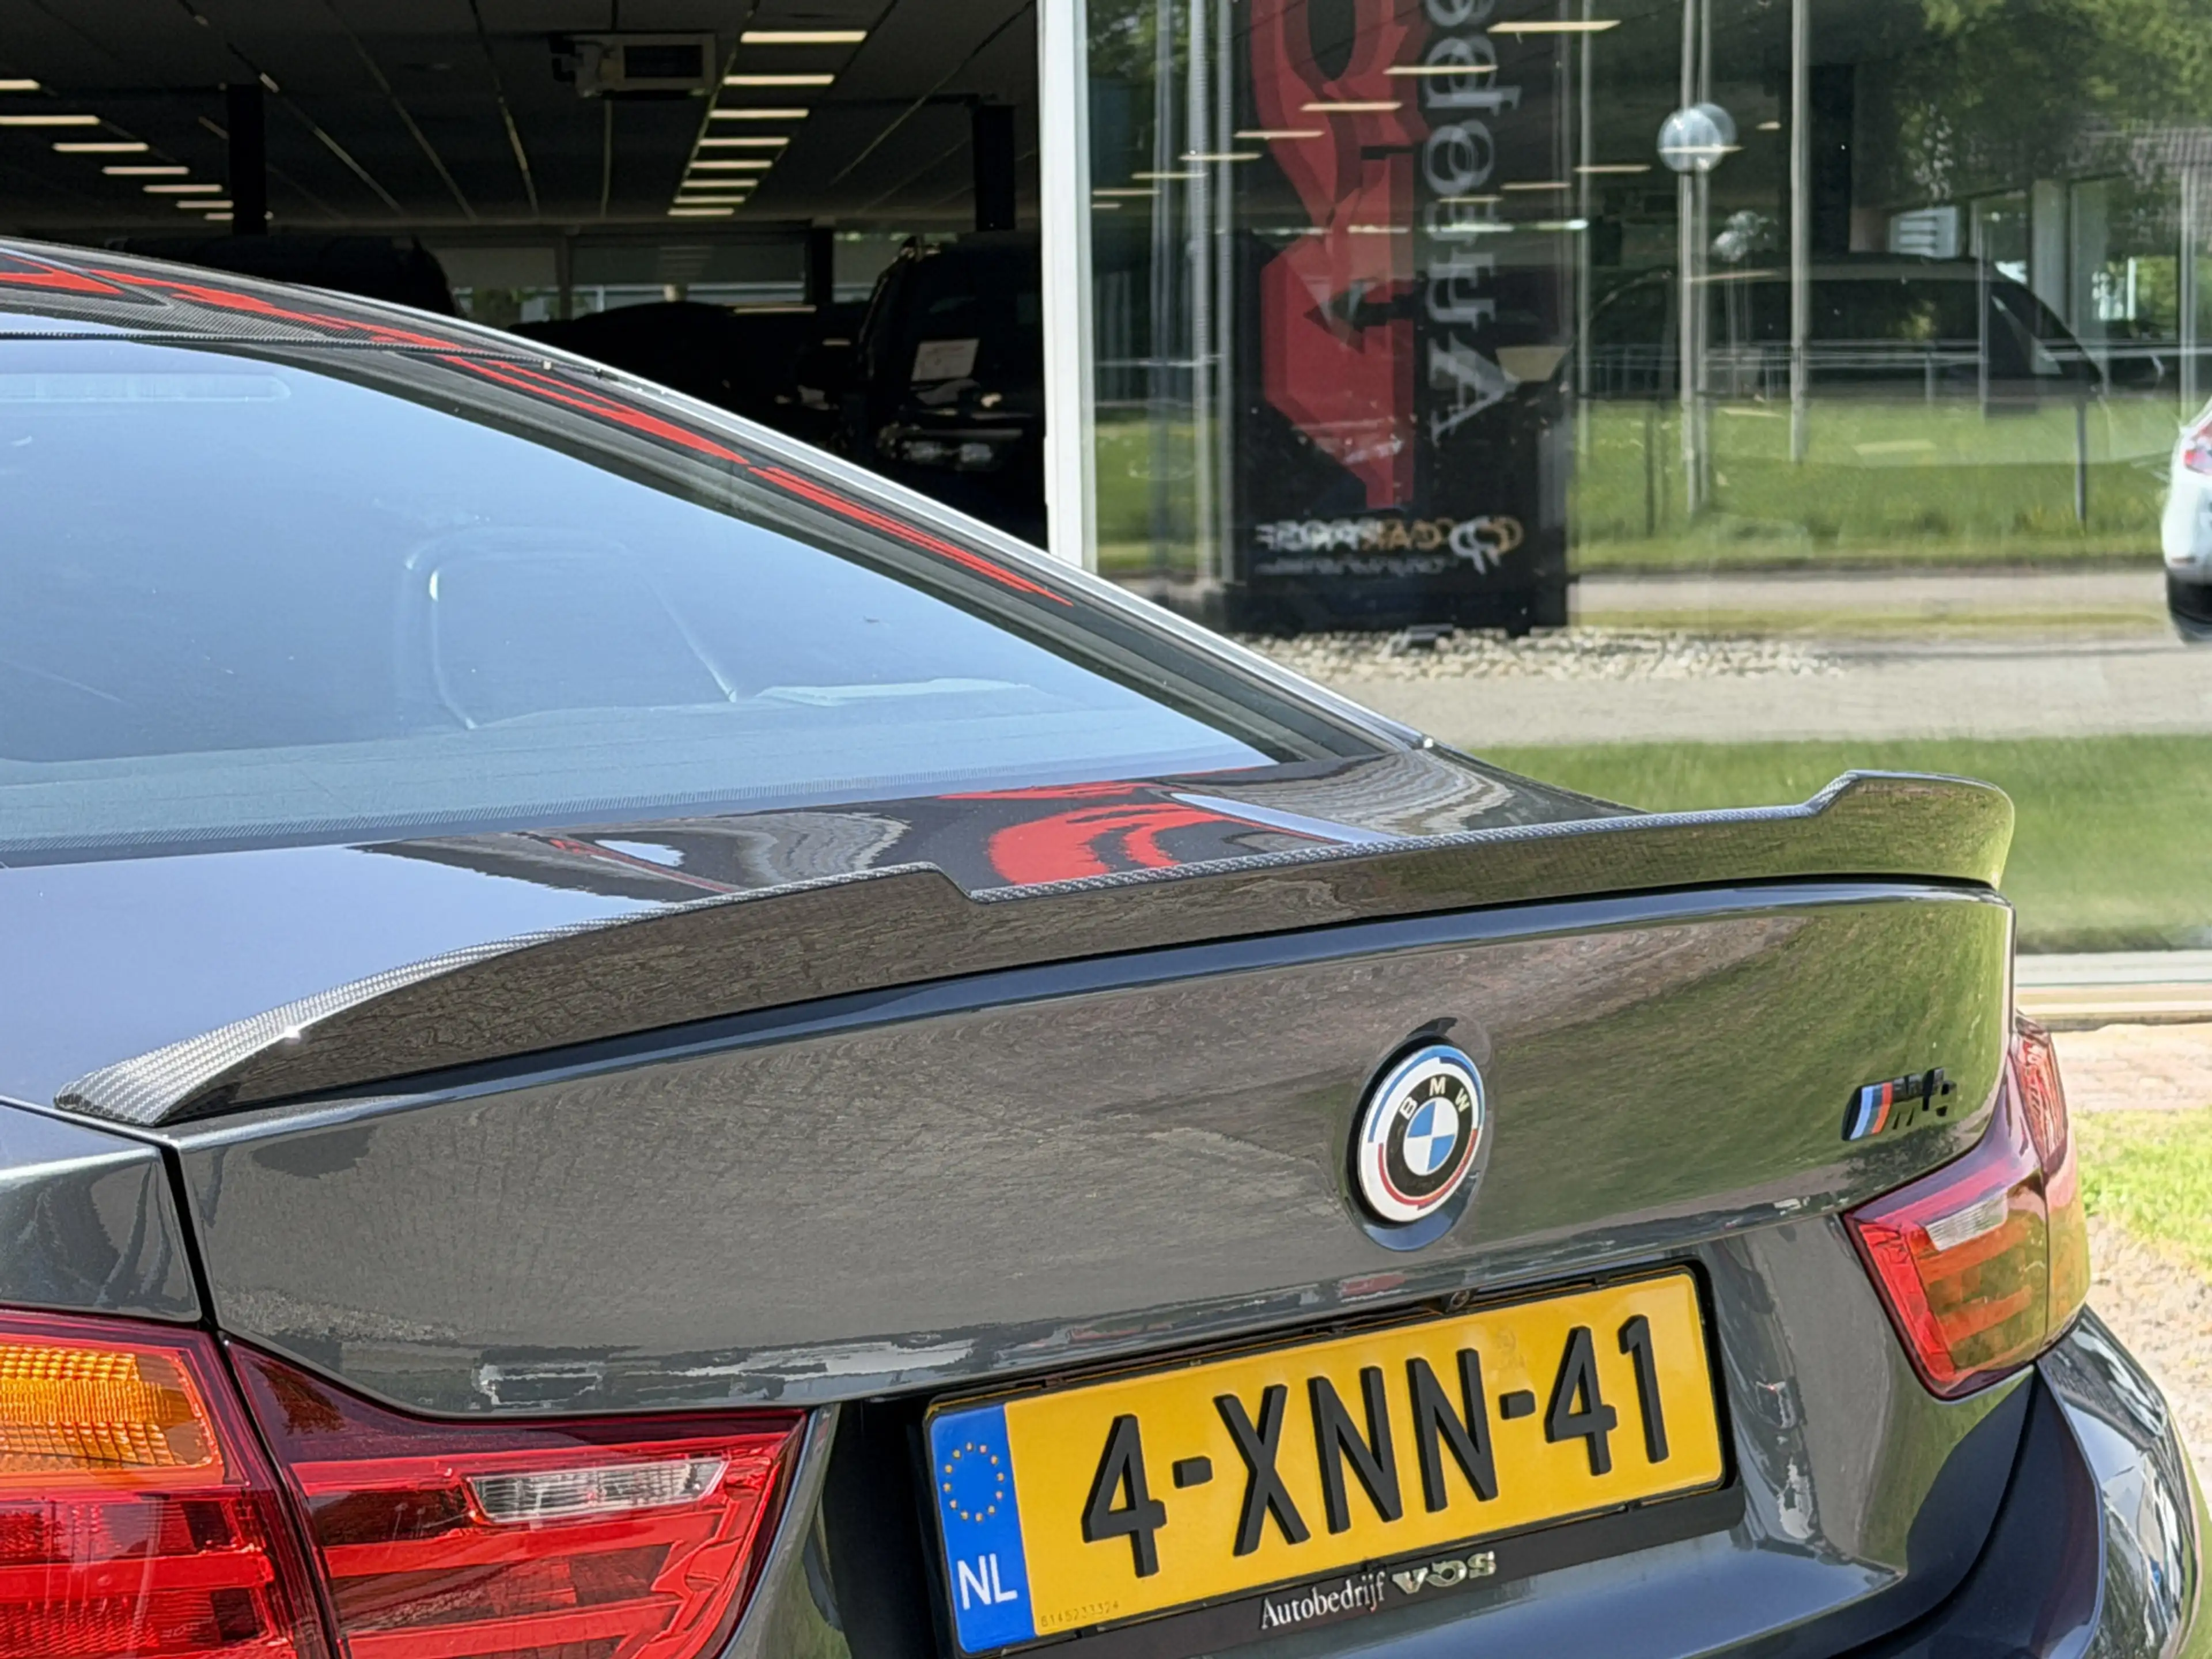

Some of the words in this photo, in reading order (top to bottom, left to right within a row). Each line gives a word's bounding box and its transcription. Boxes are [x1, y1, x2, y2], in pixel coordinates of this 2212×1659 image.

[1399, 1076, 1470, 1120] BMW
[1081, 1315, 1669, 1577] 4-XNN-41
[957, 1553, 1018, 1610] NL
[1261, 1571, 1385, 1630] Autobedrijf
